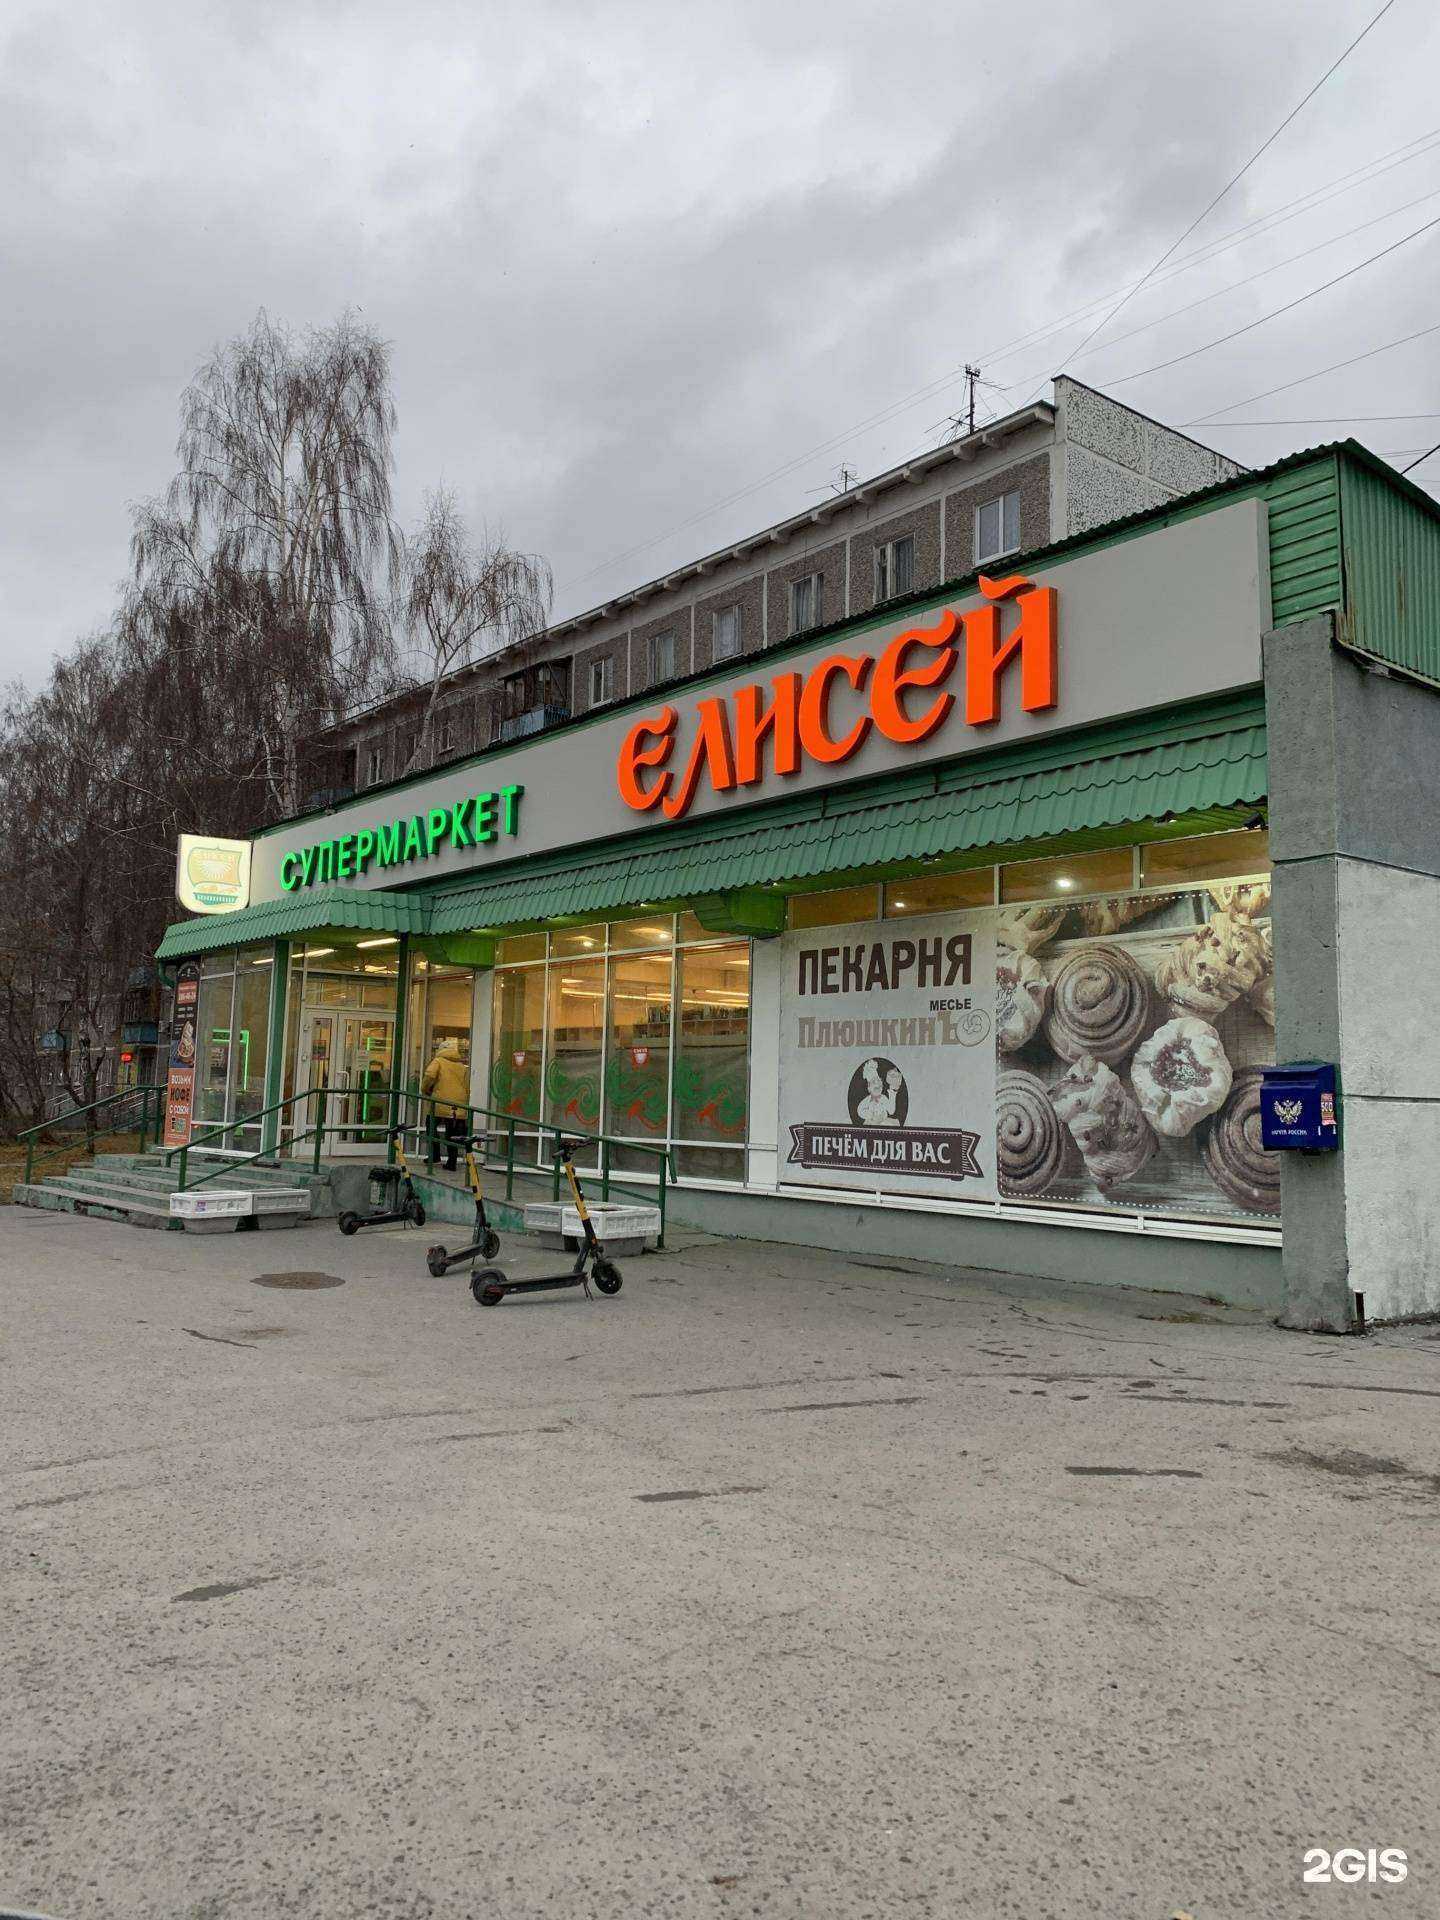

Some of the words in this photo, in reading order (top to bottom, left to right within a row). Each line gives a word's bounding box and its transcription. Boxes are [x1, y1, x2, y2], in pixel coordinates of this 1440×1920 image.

[618, 575, 1058, 819] ЕЛИСЕЙ
[280, 784, 525, 891] СУПЕРМАРКЕТ
[798, 933, 973, 995] ПЕКАРНЯ
[929, 998, 972, 1012] МЕСЬЕ
[170, 1087, 191, 1102] КОФЕ
[812, 1133, 869, 1158] ПЕЧЁМ
[869, 1139, 907, 1164] ДЛЯ
[911, 1141, 951, 1165] ВАС
